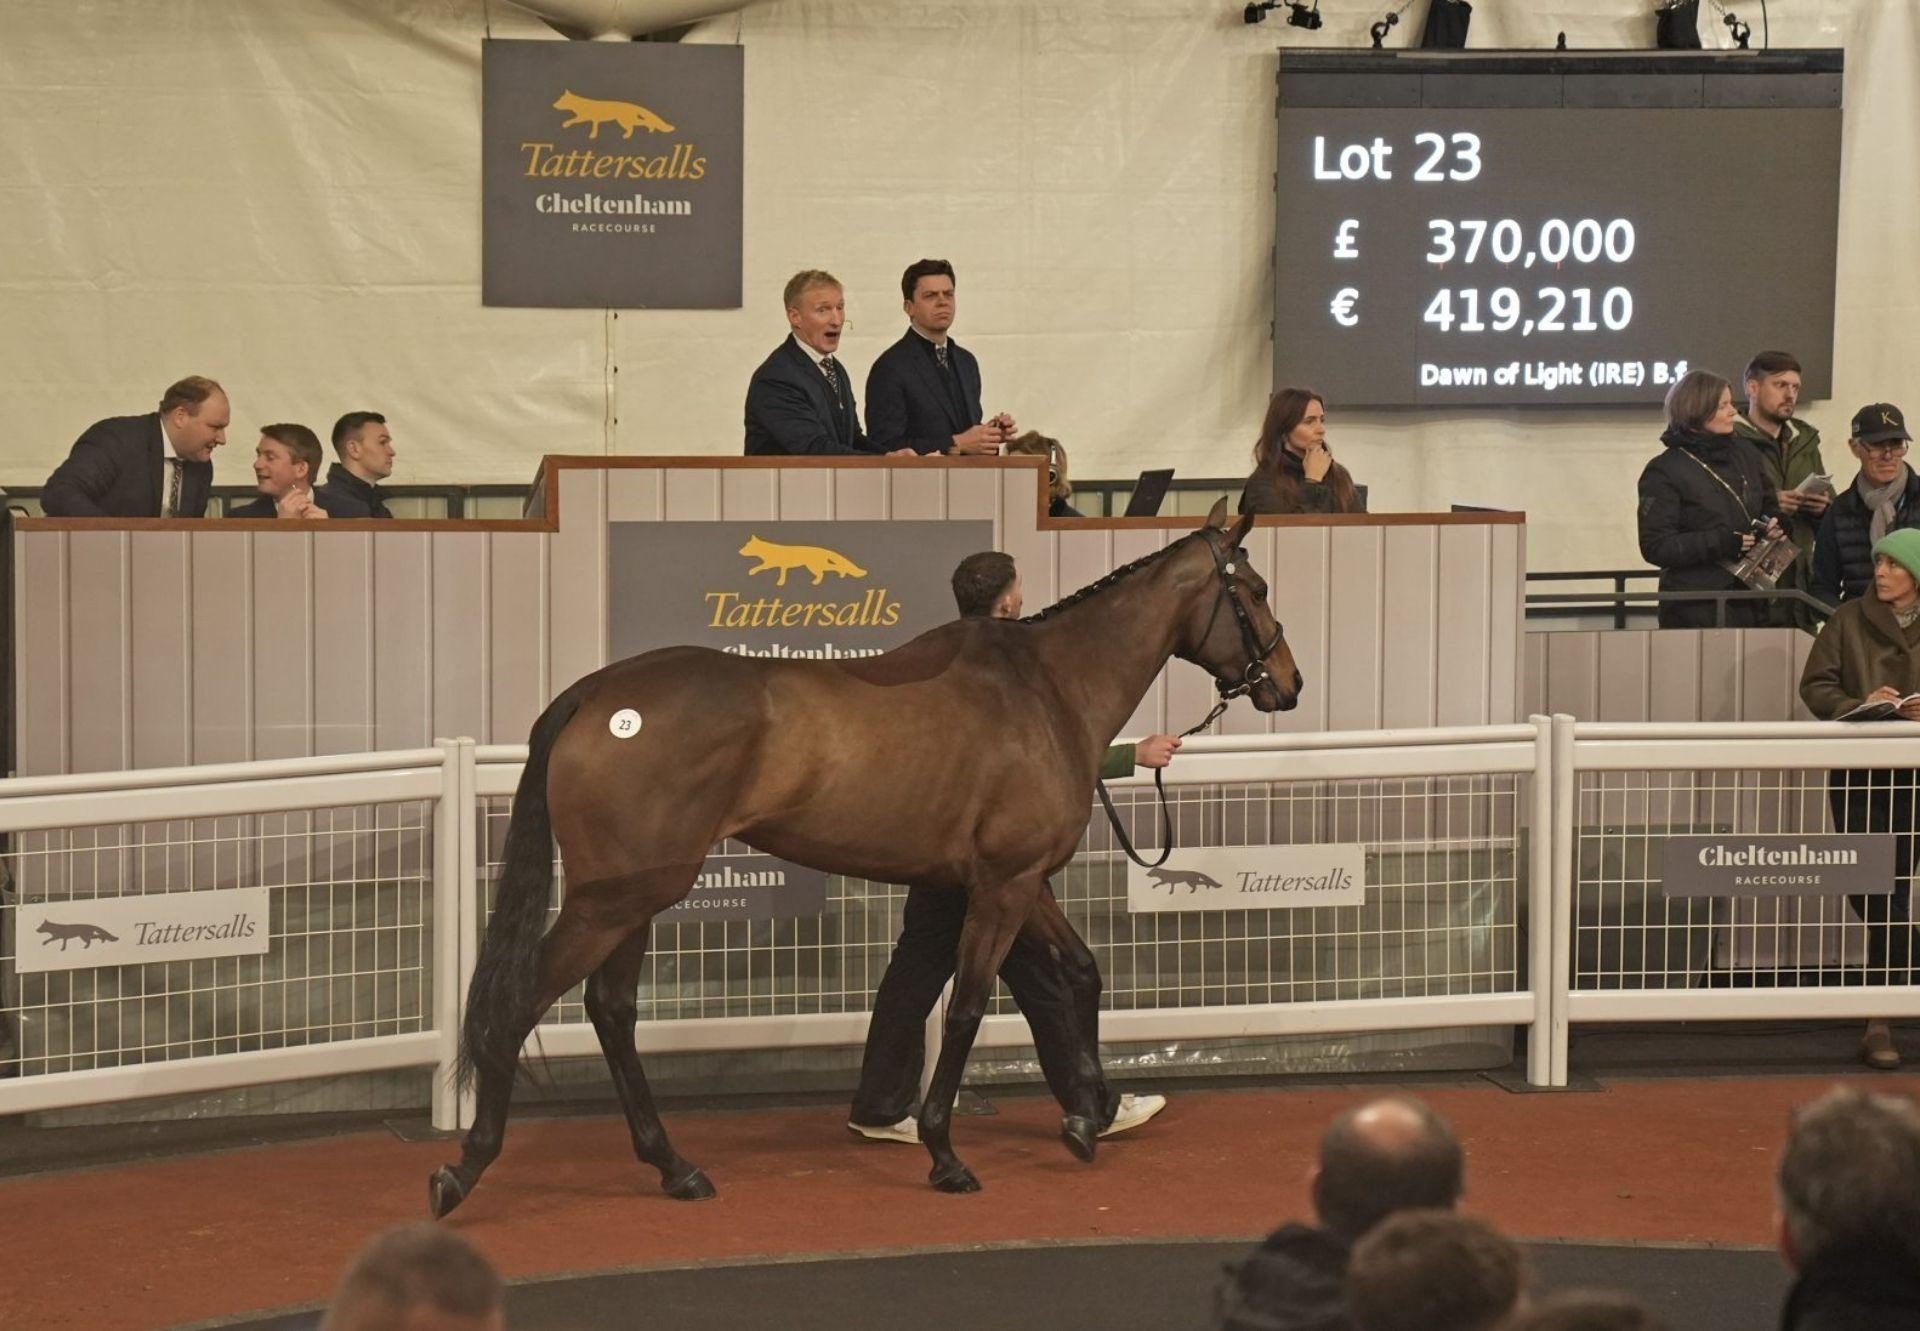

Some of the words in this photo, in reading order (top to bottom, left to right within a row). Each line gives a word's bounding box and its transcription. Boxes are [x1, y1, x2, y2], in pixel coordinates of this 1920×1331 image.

[521, 143, 707, 180] Tattersalls
[1313, 135, 1393, 181] Lot
[1413, 132, 1482, 182] 23
[535, 193, 692, 215] Cheltenham
[572, 223, 656, 233] RACECOURSE
[1333, 219, 1360, 259] £
[1426, 219, 1636, 269] 370,000
[1330, 287, 1360, 327] €
[1423, 287, 1634, 336] 419,210
[1421, 364, 1488, 386] Dawn
[1494, 361, 1520, 386] of
[1524, 361, 1584, 390] Light
[1589, 361, 1645, 387] (IRE)
[705, 588, 901, 628] Tattersalls
[619, 719, 632, 731] 23
[1698, 844, 1858, 866] Cheltenham
[1236, 867, 1352, 893] Tattersalls
[1735, 875, 1821, 885] RACECOURSE
[672, 898, 748, 910] CECOURSE
[134, 913, 256, 946] Tattersalls
